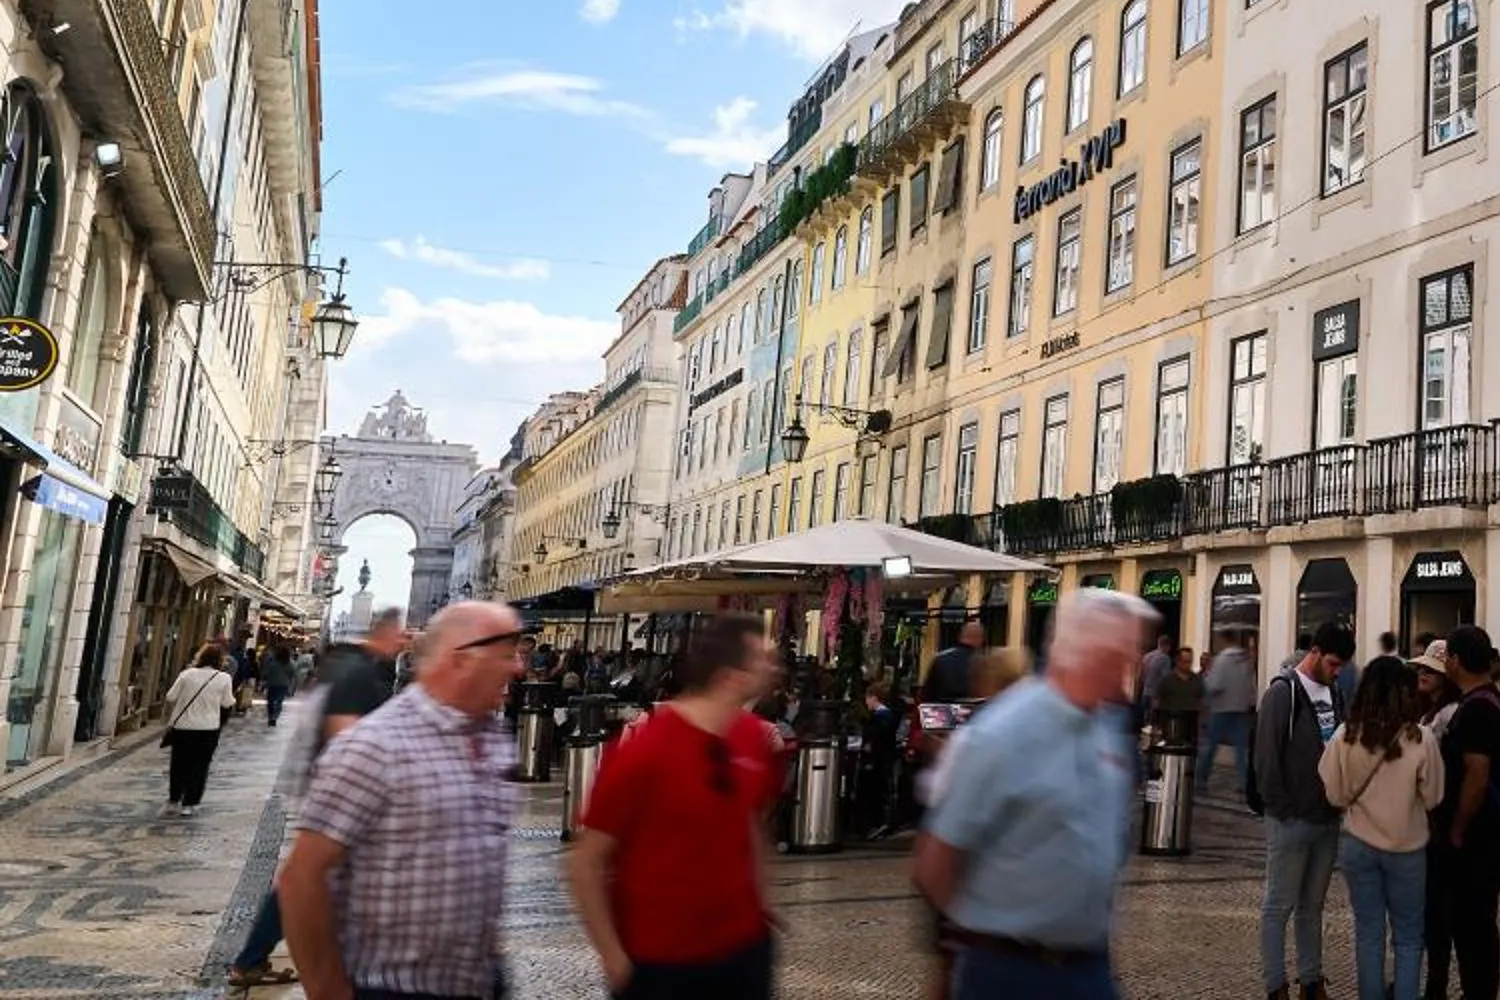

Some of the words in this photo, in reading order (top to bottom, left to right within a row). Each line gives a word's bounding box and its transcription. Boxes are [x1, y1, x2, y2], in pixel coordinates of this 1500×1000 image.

[1323, 313, 1345, 333] SALSA
[1323, 329, 1345, 349] JEANS
[0, 349, 33, 361] rilled
[1417, 562, 1439, 577] SALSA
